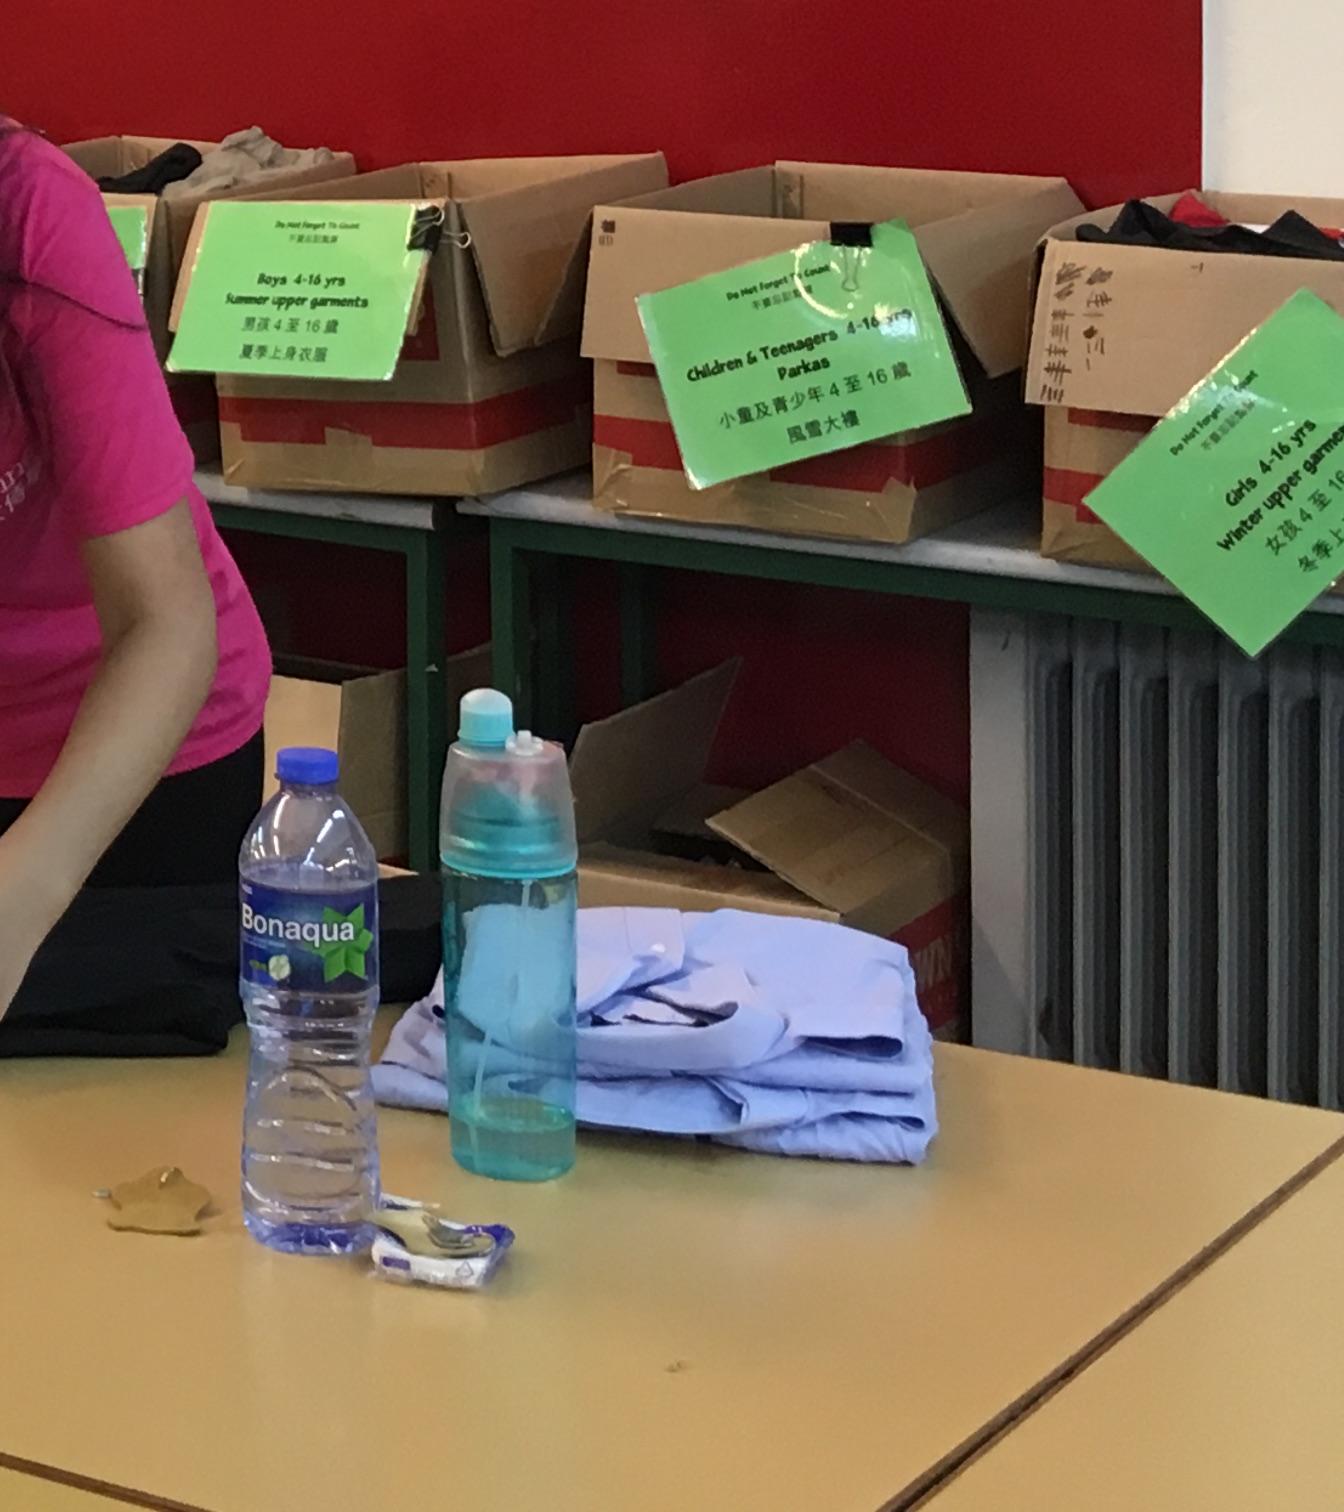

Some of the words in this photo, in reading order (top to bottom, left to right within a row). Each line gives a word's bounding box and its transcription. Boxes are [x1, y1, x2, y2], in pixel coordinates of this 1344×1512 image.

[225, 292, 270, 305] Summer
[271, 296, 308, 311] upper
[310, 296, 369, 310] garments
[257, 273, 287, 288] Boys
[293, 273, 321, 286] 4-16
[324, 276, 346, 289] yrs
[726, 291, 740, 301] Do
[740, 284, 758, 298] Not
[759, 275, 788, 292] Forget
[804, 263, 831, 278] Count
[686, 356, 744, 382] Children
[746, 350, 758, 365] &
[759, 329, 839, 362] Teenagers
[846, 315, 880, 336] 4-16
[776, 356, 831, 381] Parkas
[719, 385, 825, 430] 小童及青少年
[1181, 427, 1200, 445] Not
[1196, 403, 1225, 429] Forget
[1225, 476, 1258, 507] Girls
[1258, 441, 1291, 475] 4-16
[1290, 419, 1317, 448] yrs
[1216, 507, 1263, 551] Winter
[1262, 469, 1302, 510] upper
[242, 902, 355, 948] Bonaqua
